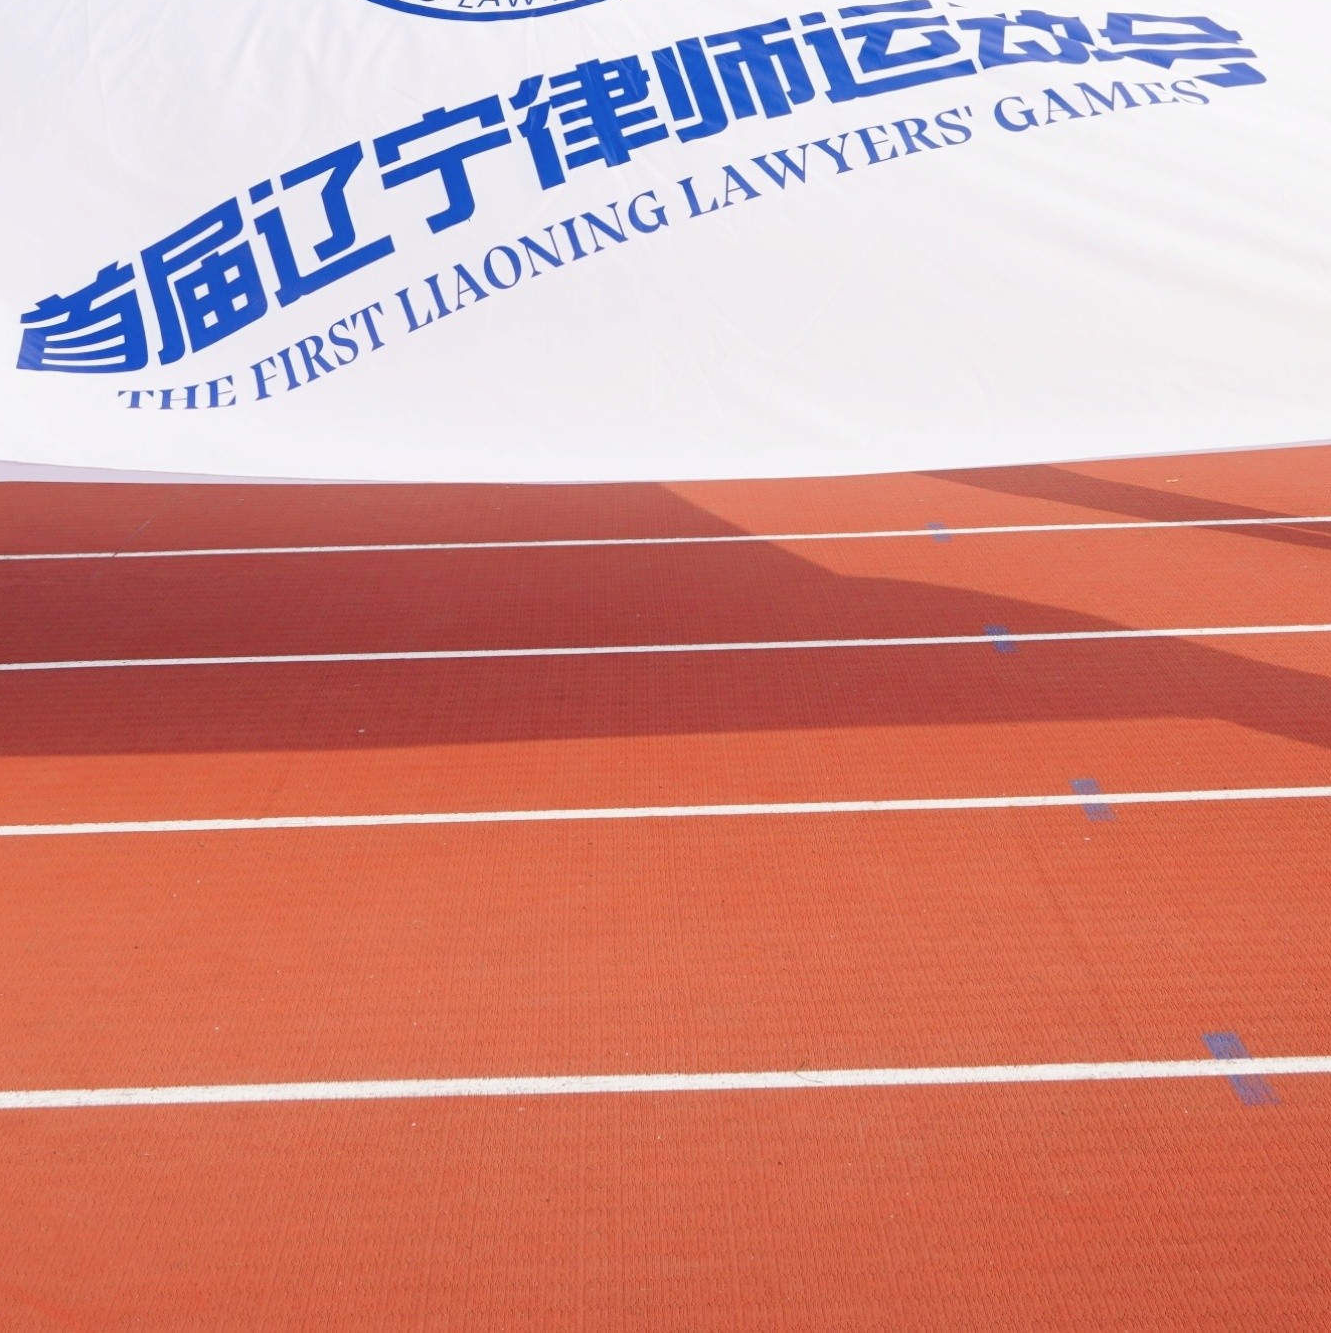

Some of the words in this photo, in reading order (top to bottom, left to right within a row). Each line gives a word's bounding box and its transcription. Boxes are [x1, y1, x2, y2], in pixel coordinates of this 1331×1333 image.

[117, 375, 237, 410] THE
[249, 301, 387, 401] FIRST
[394, 189, 669, 334] LIAONING
[677, 105, 973, 218] LAWYERS'
[993, 79, 1211, 133] GAMES
